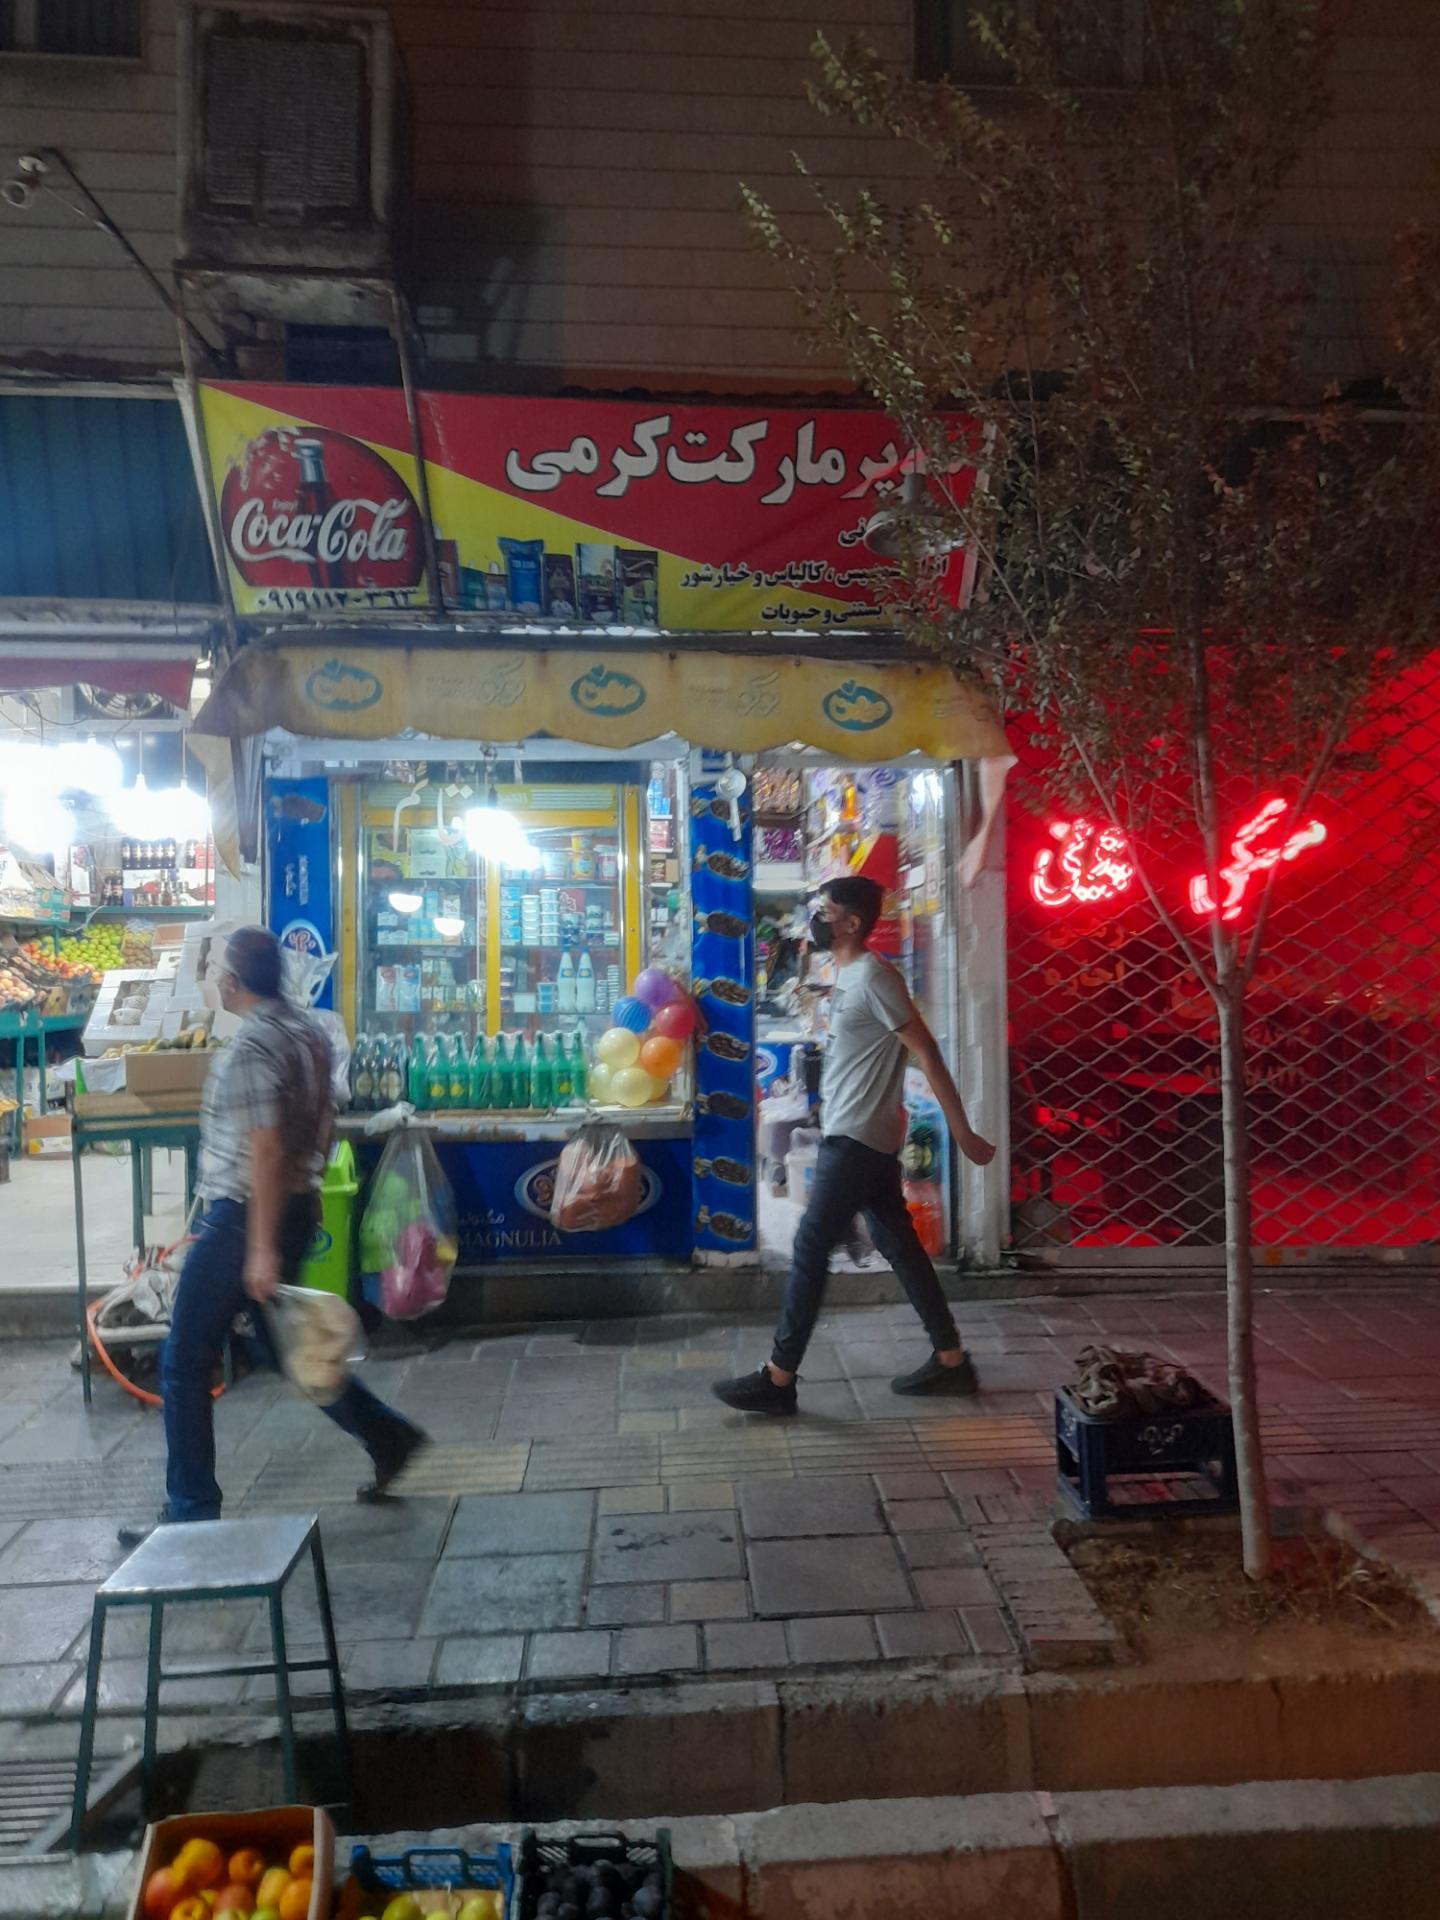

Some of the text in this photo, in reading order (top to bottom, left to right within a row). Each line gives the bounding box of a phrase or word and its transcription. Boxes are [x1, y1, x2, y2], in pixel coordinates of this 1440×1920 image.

[505, 414, 966, 504] وپر مارکت کرمی
[231, 497, 408, 564] Coca-Cola
[765, 560, 828, 588] کالباس
[762, 603, 821, 625] حبوبات
